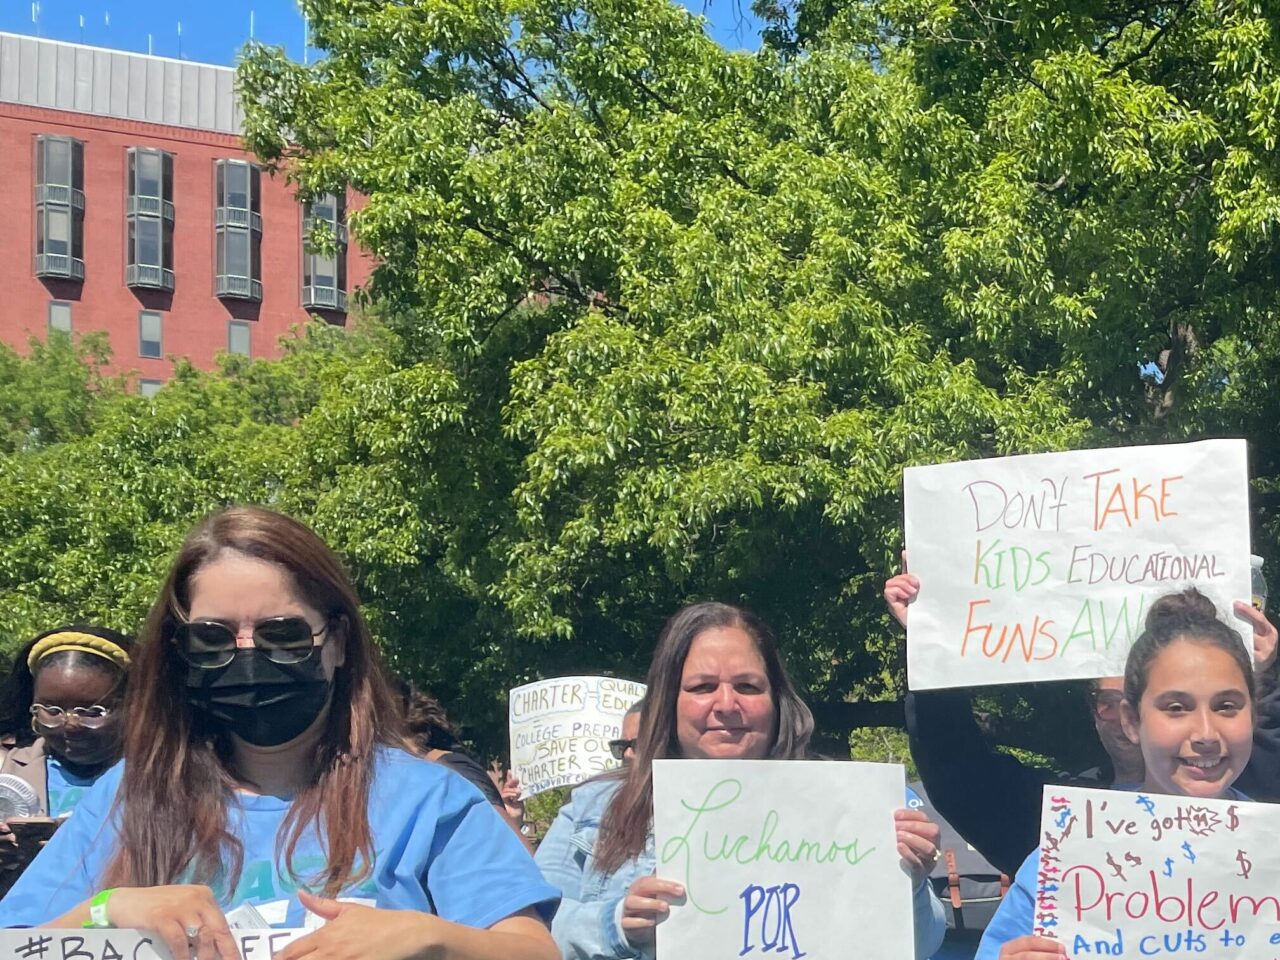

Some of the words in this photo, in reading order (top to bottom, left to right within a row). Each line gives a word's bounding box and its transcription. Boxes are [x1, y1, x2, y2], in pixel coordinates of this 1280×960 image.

[1083, 468, 1183, 532] TAKE
[974, 539, 1052, 591] KIDS
[1067, 545, 1225, 584] EDUCATIONAL
[961, 599, 1059, 663] FUNS
[512, 683, 583, 717] CHARTER
[515, 724, 562, 750] COLLEGE
[572, 721, 620, 739] PREPA
[536, 738, 580, 760] SAVE
[520, 754, 582, 786] CHARTER
[1085, 798, 1139, 839] I've
[1150, 806, 1188, 842] got
[661, 778, 876, 915] Luchamos
[739, 882, 807, 960] POR
[1073, 929, 1125, 956] And
[1219, 930, 1246, 949] to
